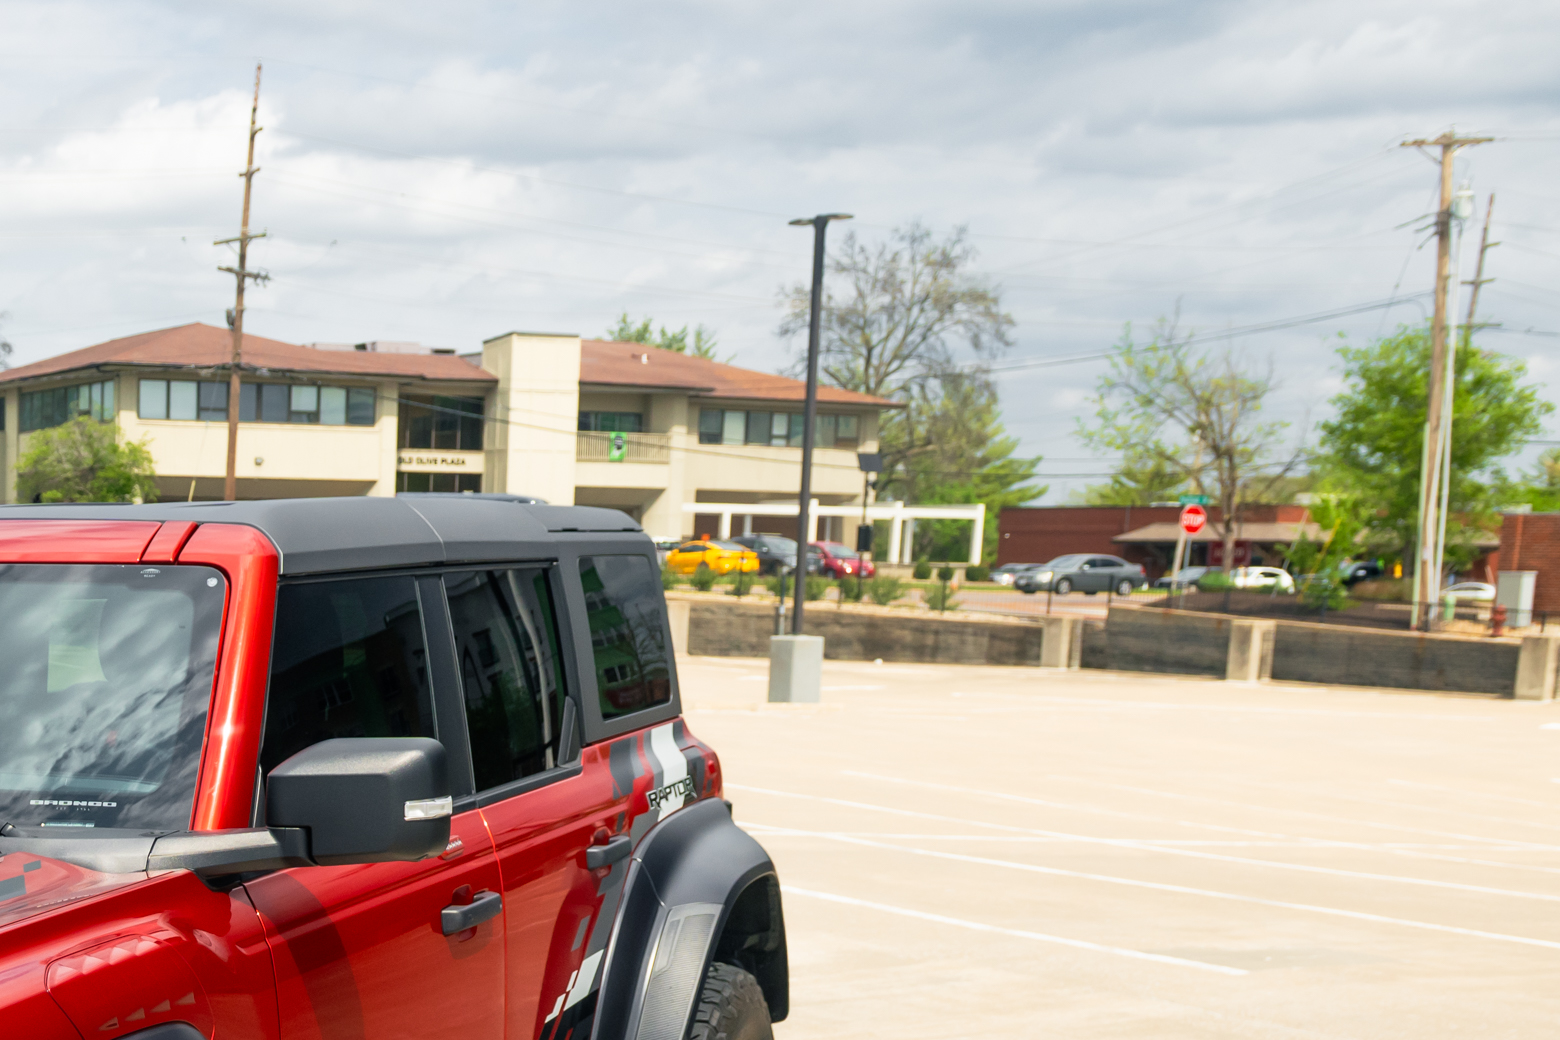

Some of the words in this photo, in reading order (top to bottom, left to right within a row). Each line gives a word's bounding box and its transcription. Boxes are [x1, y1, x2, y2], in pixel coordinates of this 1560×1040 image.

[416, 457, 438, 466] OLIVE
[440, 457, 466, 466] PLAZA
[1182, 513, 1205, 526] STOP
[646, 775, 697, 810] RAPTOR
